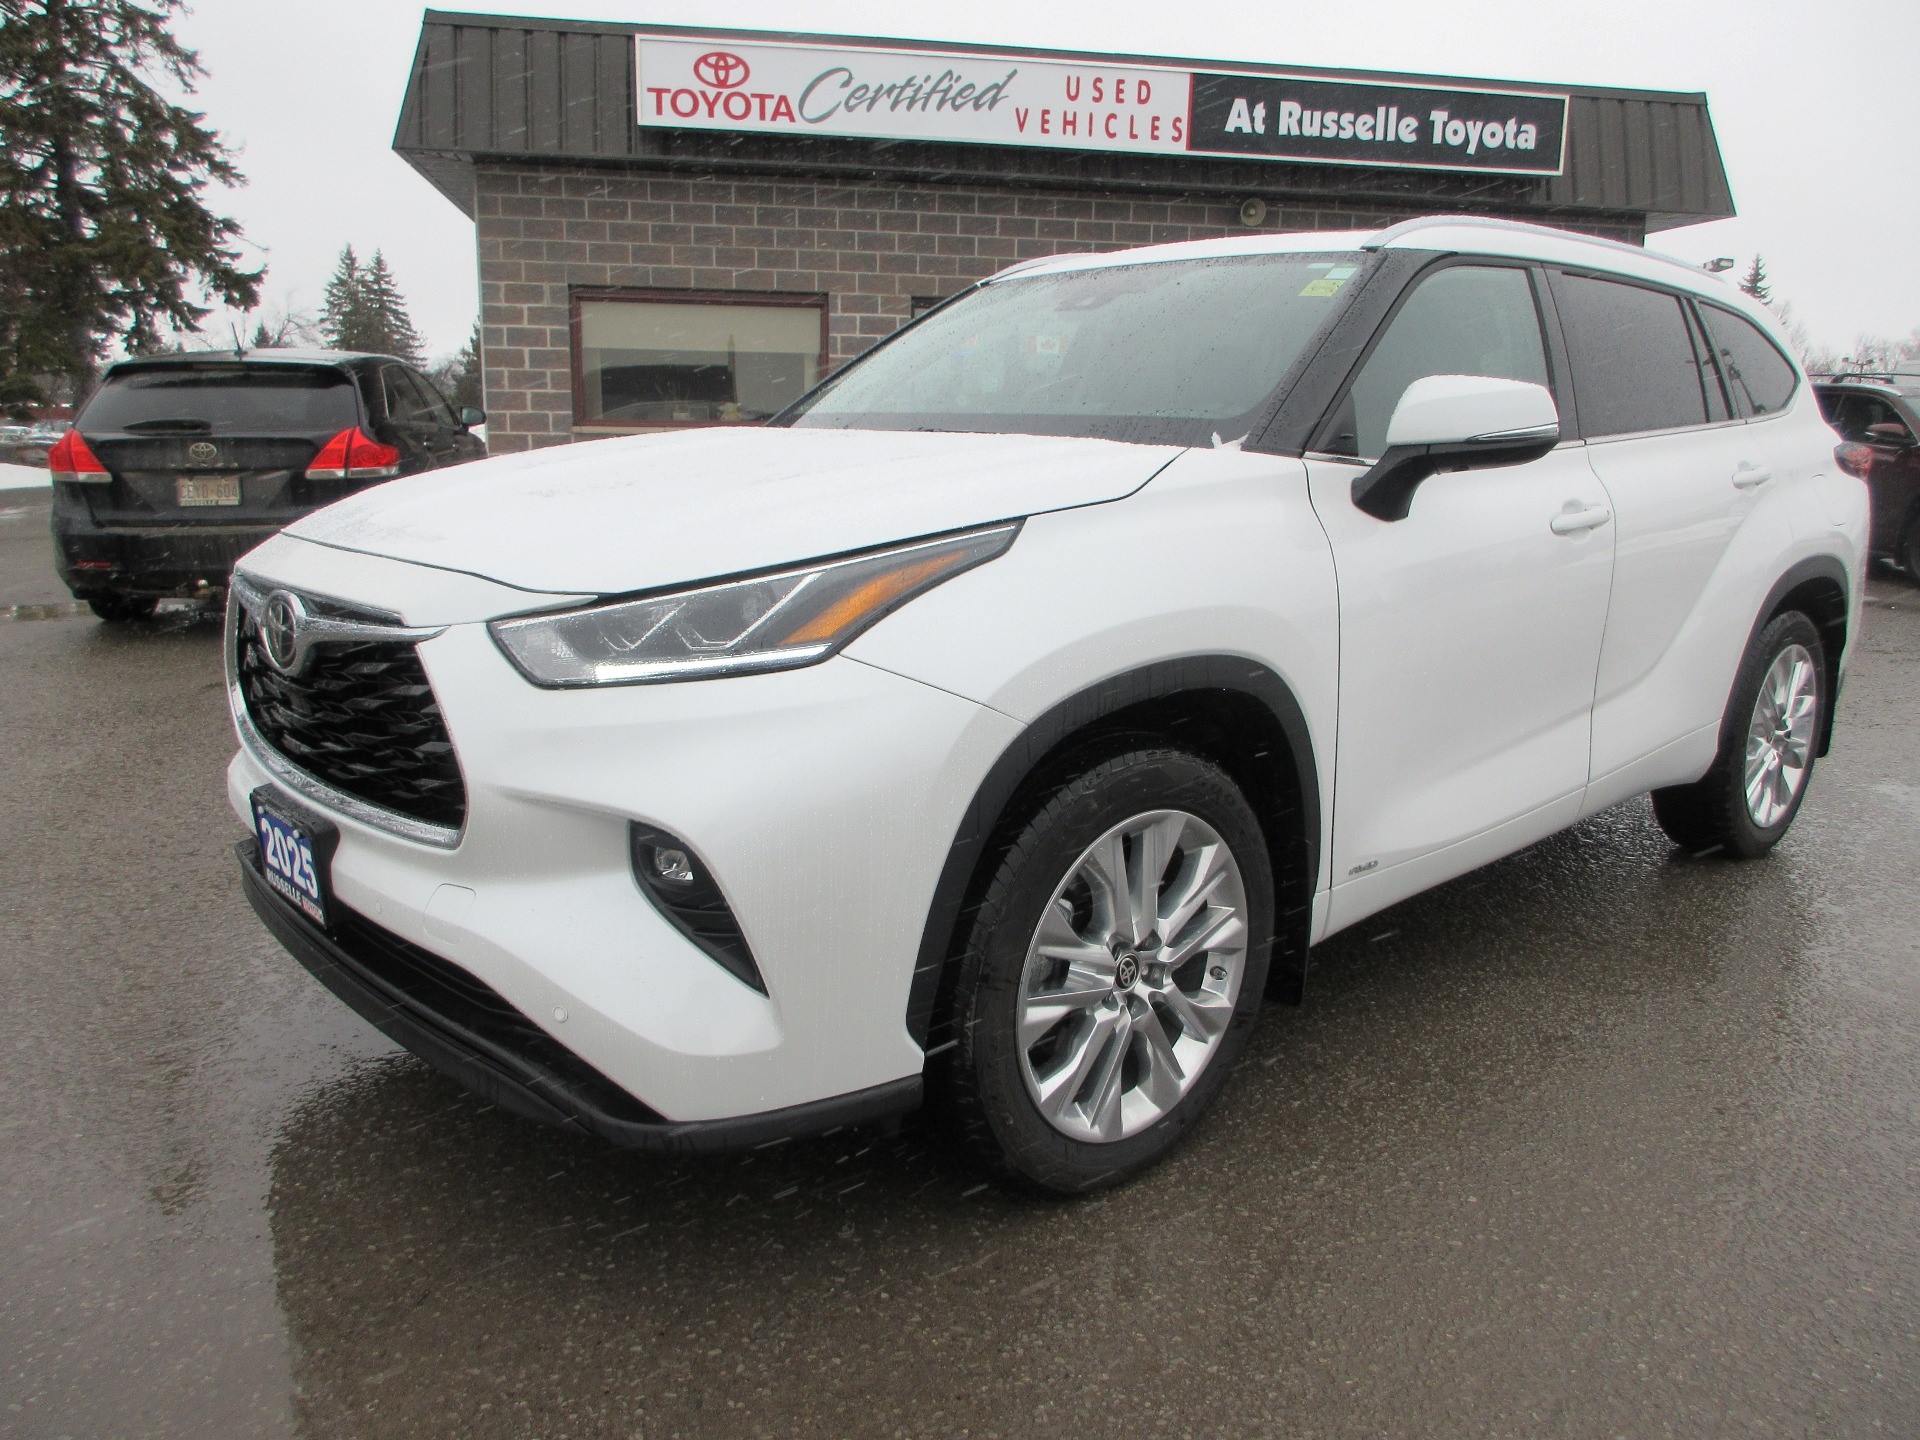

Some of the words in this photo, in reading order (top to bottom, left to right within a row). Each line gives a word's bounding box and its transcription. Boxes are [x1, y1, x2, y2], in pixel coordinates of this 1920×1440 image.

[646, 87, 797, 123] TOYOTA
[799, 67, 1019, 123] Certified
[1065, 75, 1152, 105] USED
[1015, 107, 1184, 143] VEHICLES
[1224, 98, 1266, 135] At
[1278, 100, 1418, 144] Russelle
[1429, 110, 1538, 155] Toyota
[261, 817, 319, 899] 2025
